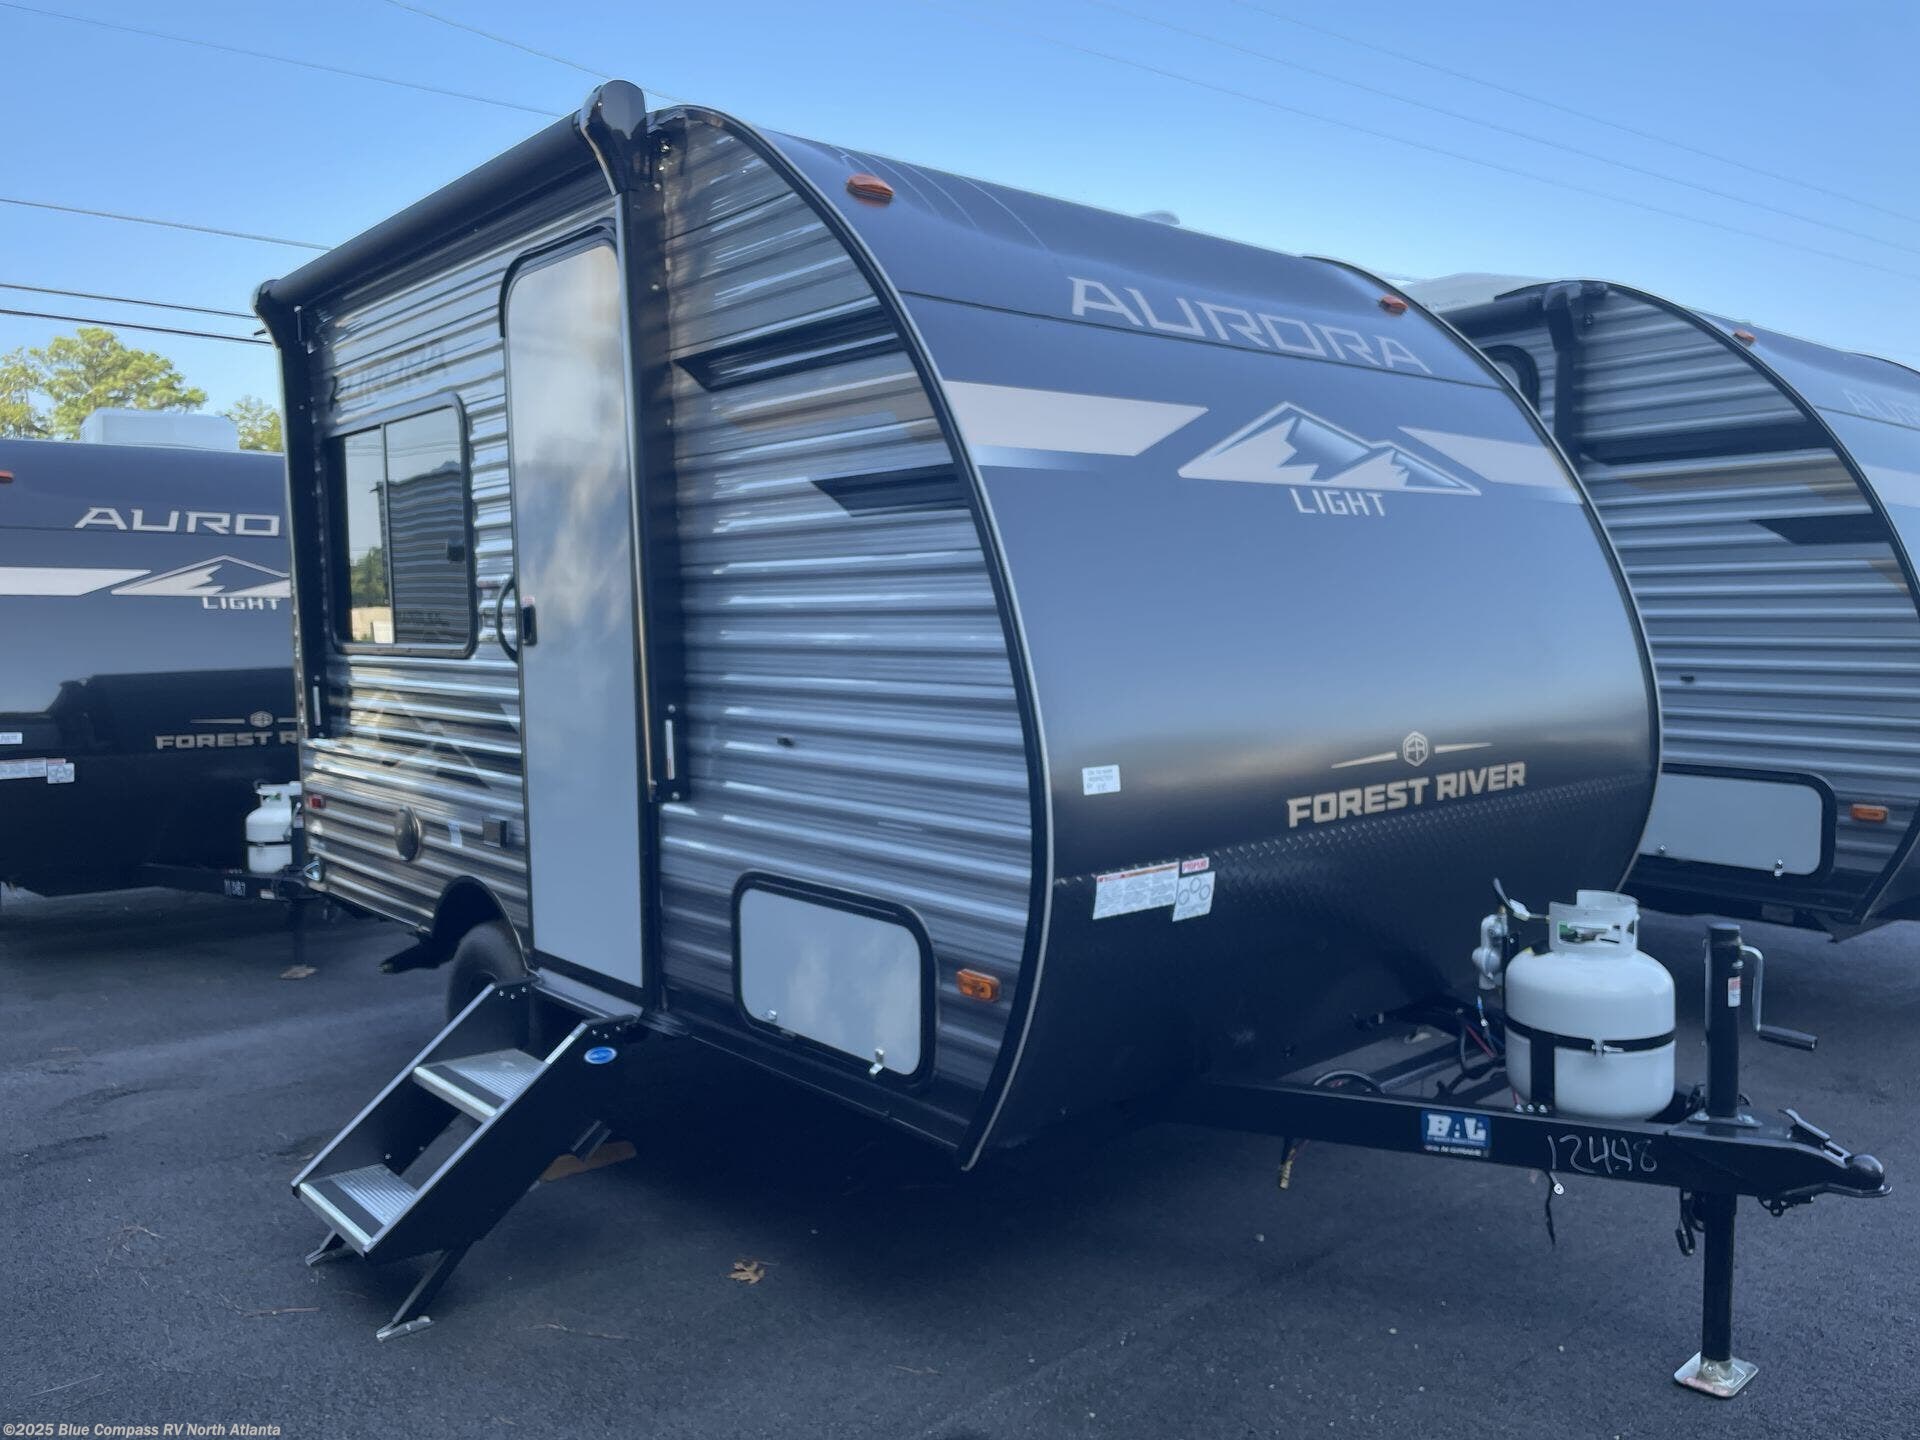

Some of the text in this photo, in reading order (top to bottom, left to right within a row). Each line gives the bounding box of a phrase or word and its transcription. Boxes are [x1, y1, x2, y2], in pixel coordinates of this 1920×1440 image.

[1067, 276, 1432, 374] AURORA
[1289, 488, 1386, 517] LIGHT
[74, 507, 280, 537] AURO
[202, 597, 281, 610] LIGHT
[155, 732, 273, 750] FOREST
[1286, 761, 1526, 829] FOREST RIVER
